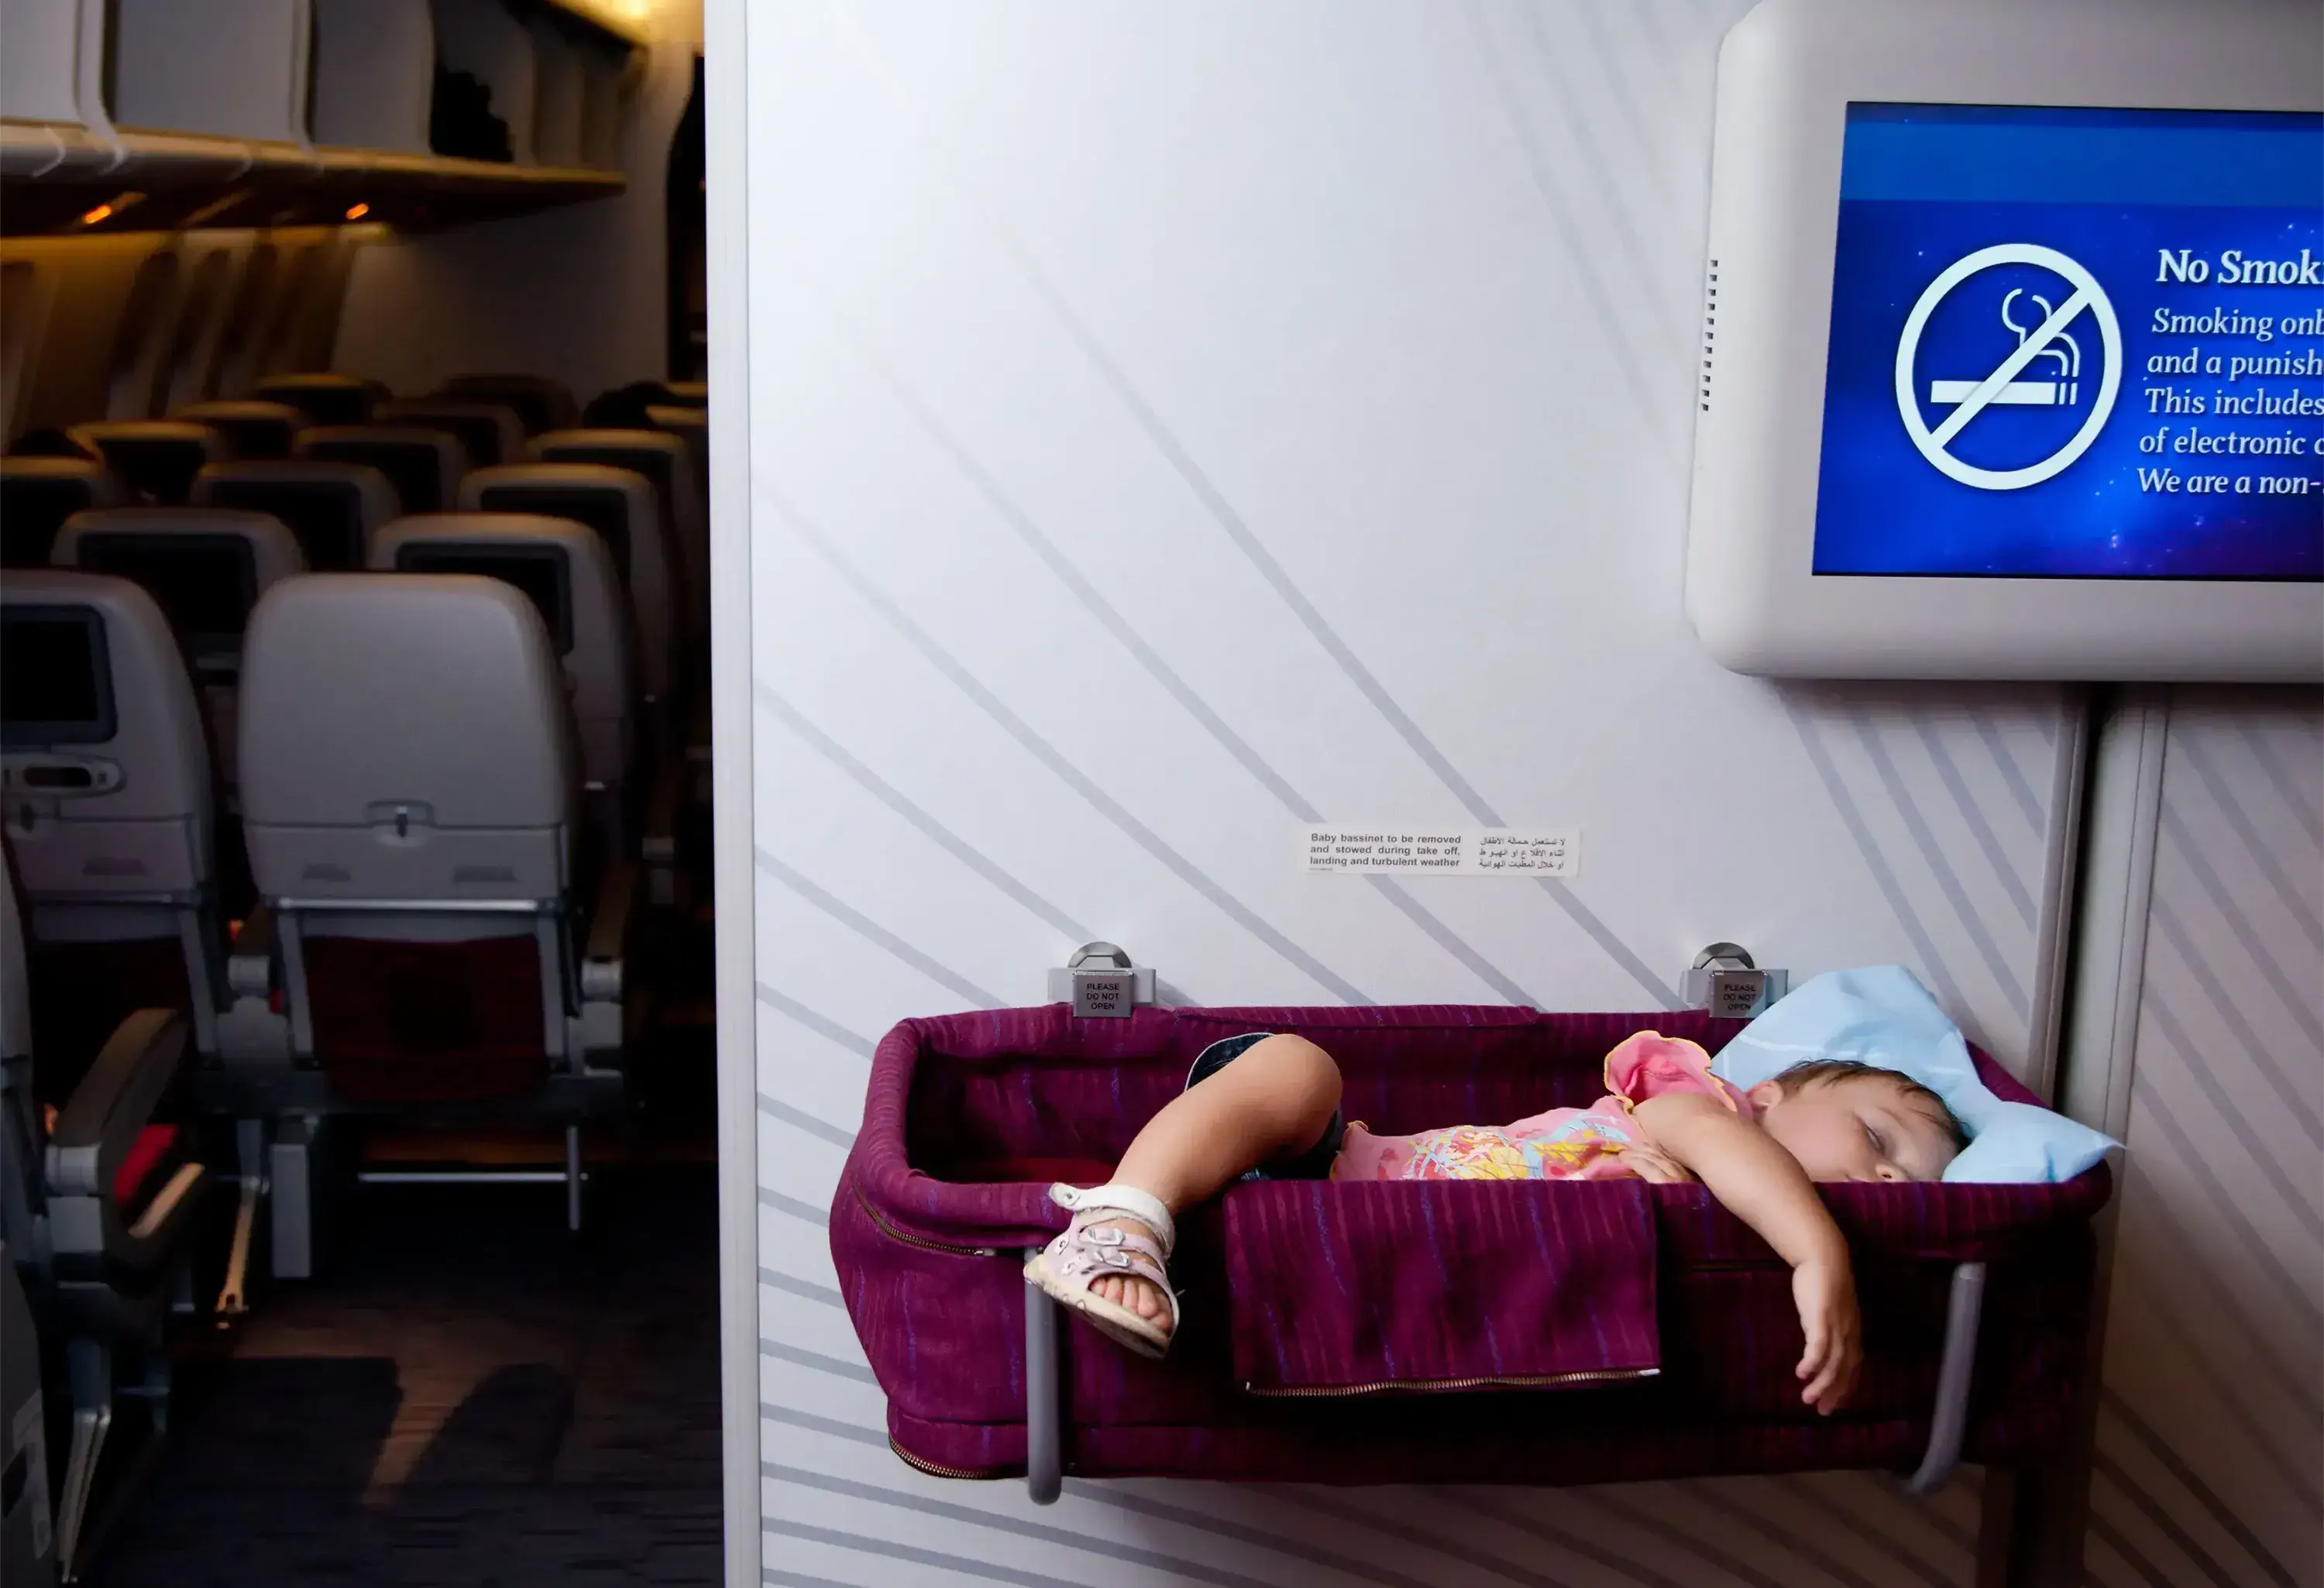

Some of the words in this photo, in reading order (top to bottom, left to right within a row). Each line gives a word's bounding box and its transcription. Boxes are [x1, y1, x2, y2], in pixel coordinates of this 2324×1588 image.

[2156, 249, 2209, 283] No
[2218, 249, 2324, 284] Smok
[2152, 307, 2274, 342] Smoking
[2147, 347, 2199, 374] and
[2205, 356, 2222, 374] a
[2145, 387, 2205, 414] This
[2214, 388, 2324, 415] includes
[2140, 427, 2169, 453] of
[2174, 427, 2305, 455] electronic
[2137, 467, 2181, 493] We
[2187, 476, 2229, 493] are
[2235, 476, 2250, 493] a
[2258, 476, 2324, 494] non-
[1311, 834, 1336, 844] Baby
[1341, 834, 1383, 843] bassinet
[1378, 846, 1411, 856] during
[1310, 856, 1347, 867] landing
[1350, 857, 1369, 865] and
[1372, 857, 1417, 866] turbulent
[1420, 858, 1460, 867] weather
[1086, 982, 1119, 991] PLEASE
